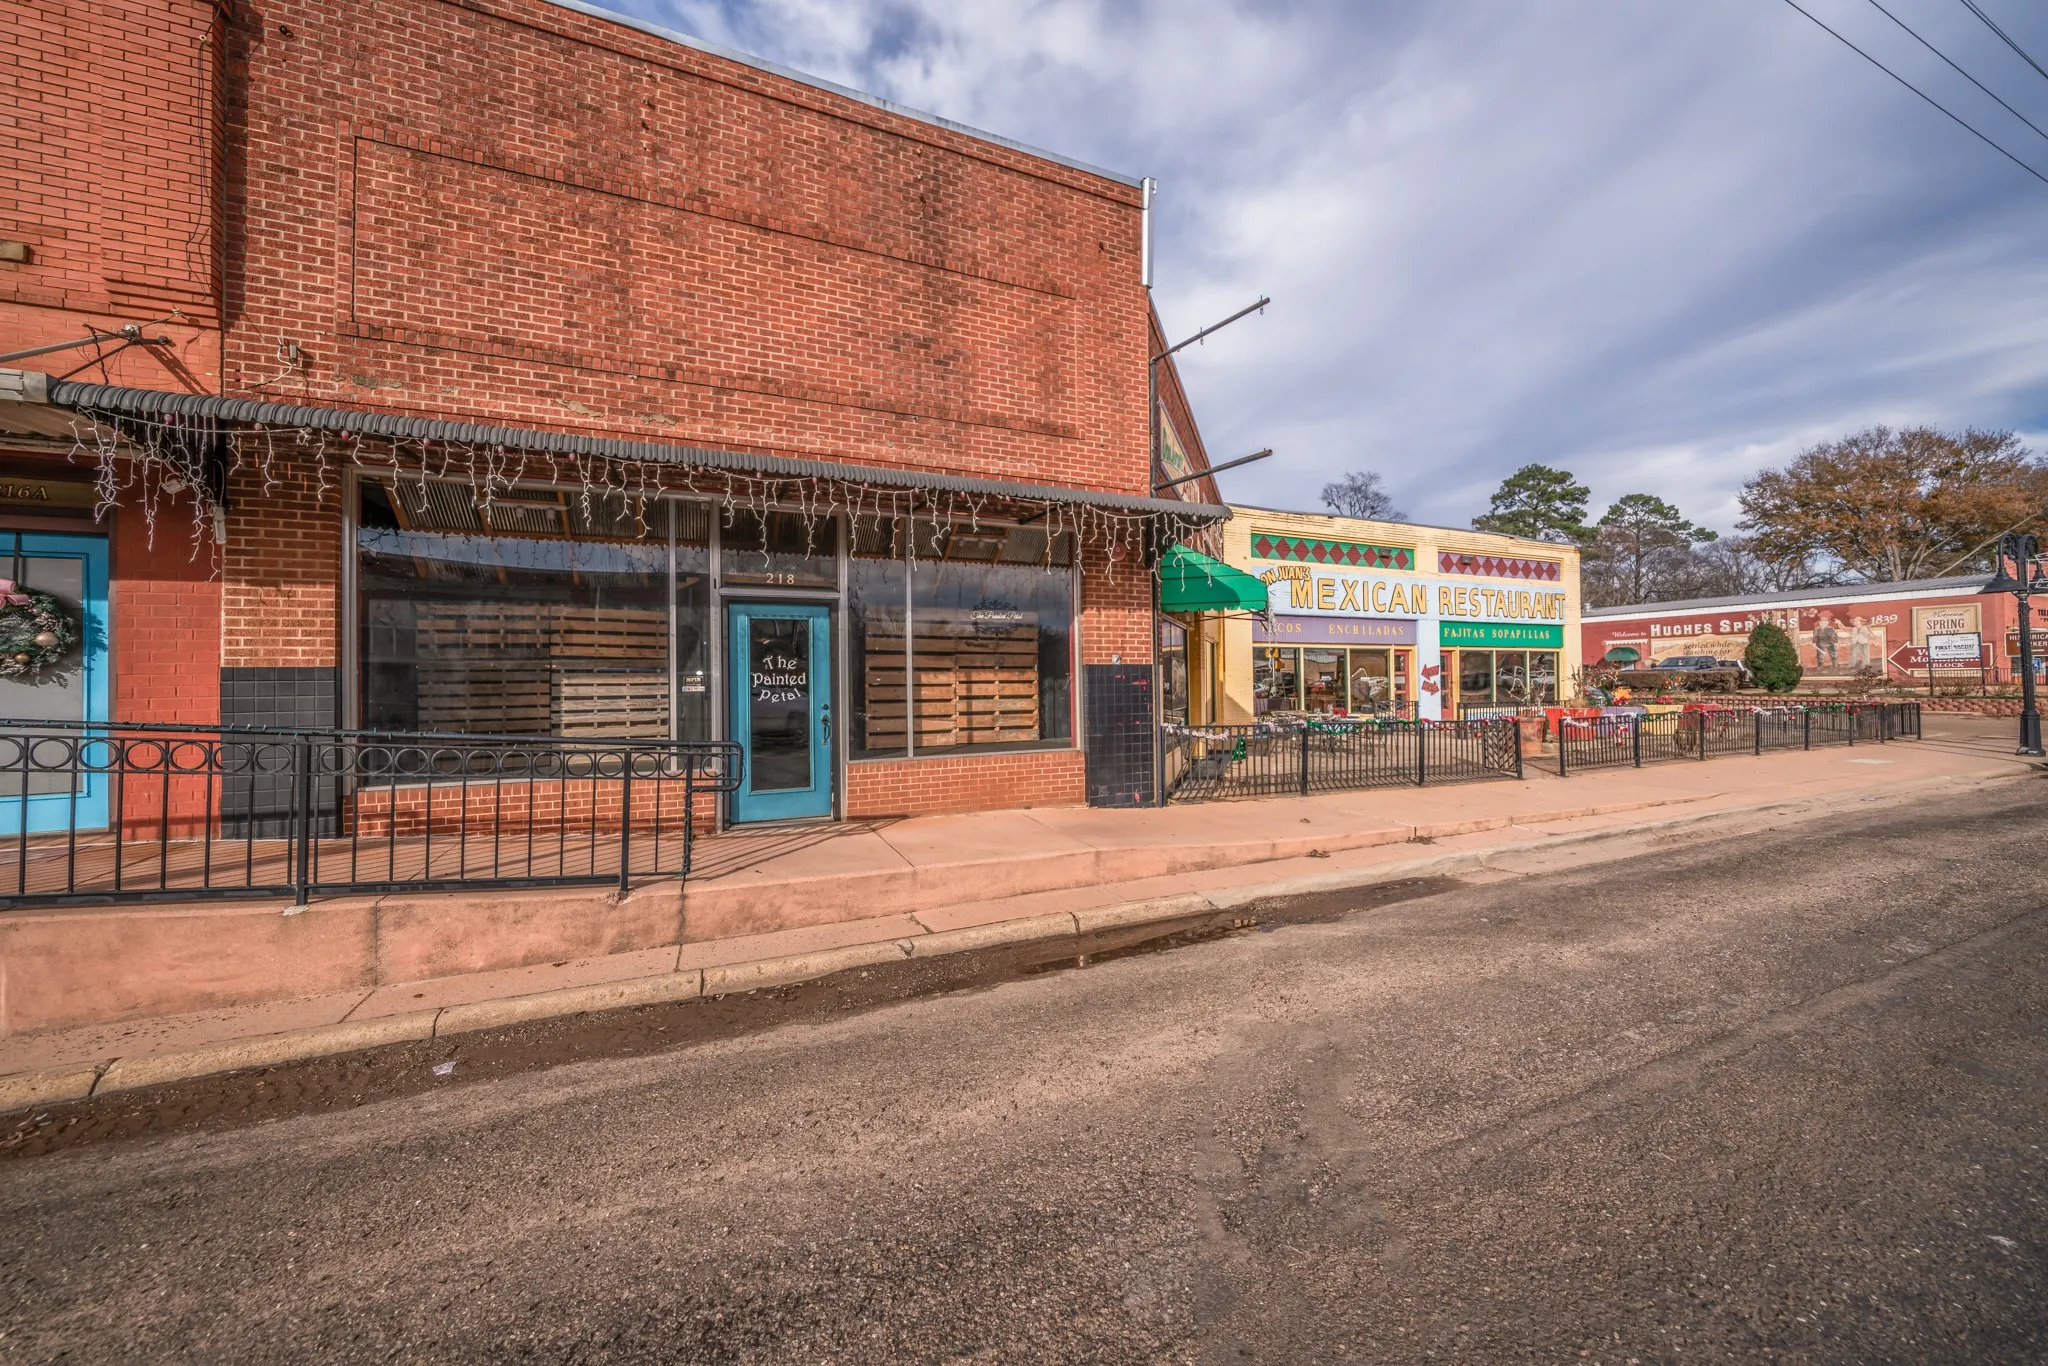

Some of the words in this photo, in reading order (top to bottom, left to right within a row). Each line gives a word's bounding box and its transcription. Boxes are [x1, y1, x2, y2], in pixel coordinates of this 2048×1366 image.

[0, 484, 50, 500] 16A
[766, 572, 795, 585] 218
[1260, 569, 1277, 587] ON
[1291, 578, 1427, 614] MEXICAN
[1439, 586, 1566, 619] RESTAURANT
[1870, 613, 1898, 626] 1839
[1926, 618, 1965, 630] SPRING
[1328, 624, 1404, 636] ENCHILADAS
[1444, 628, 1485, 638] FAJITAS
[1492, 629, 1550, 639] SOPAPILLAS
[1650, 624, 1712, 637] HUGHES
[1719, 618, 1798, 633] SPRGS
[1683, 642, 1708, 650] Settled
[763, 655, 797, 670] The
[751, 672, 806, 688] Painted
[758, 687, 801, 703] Petal
